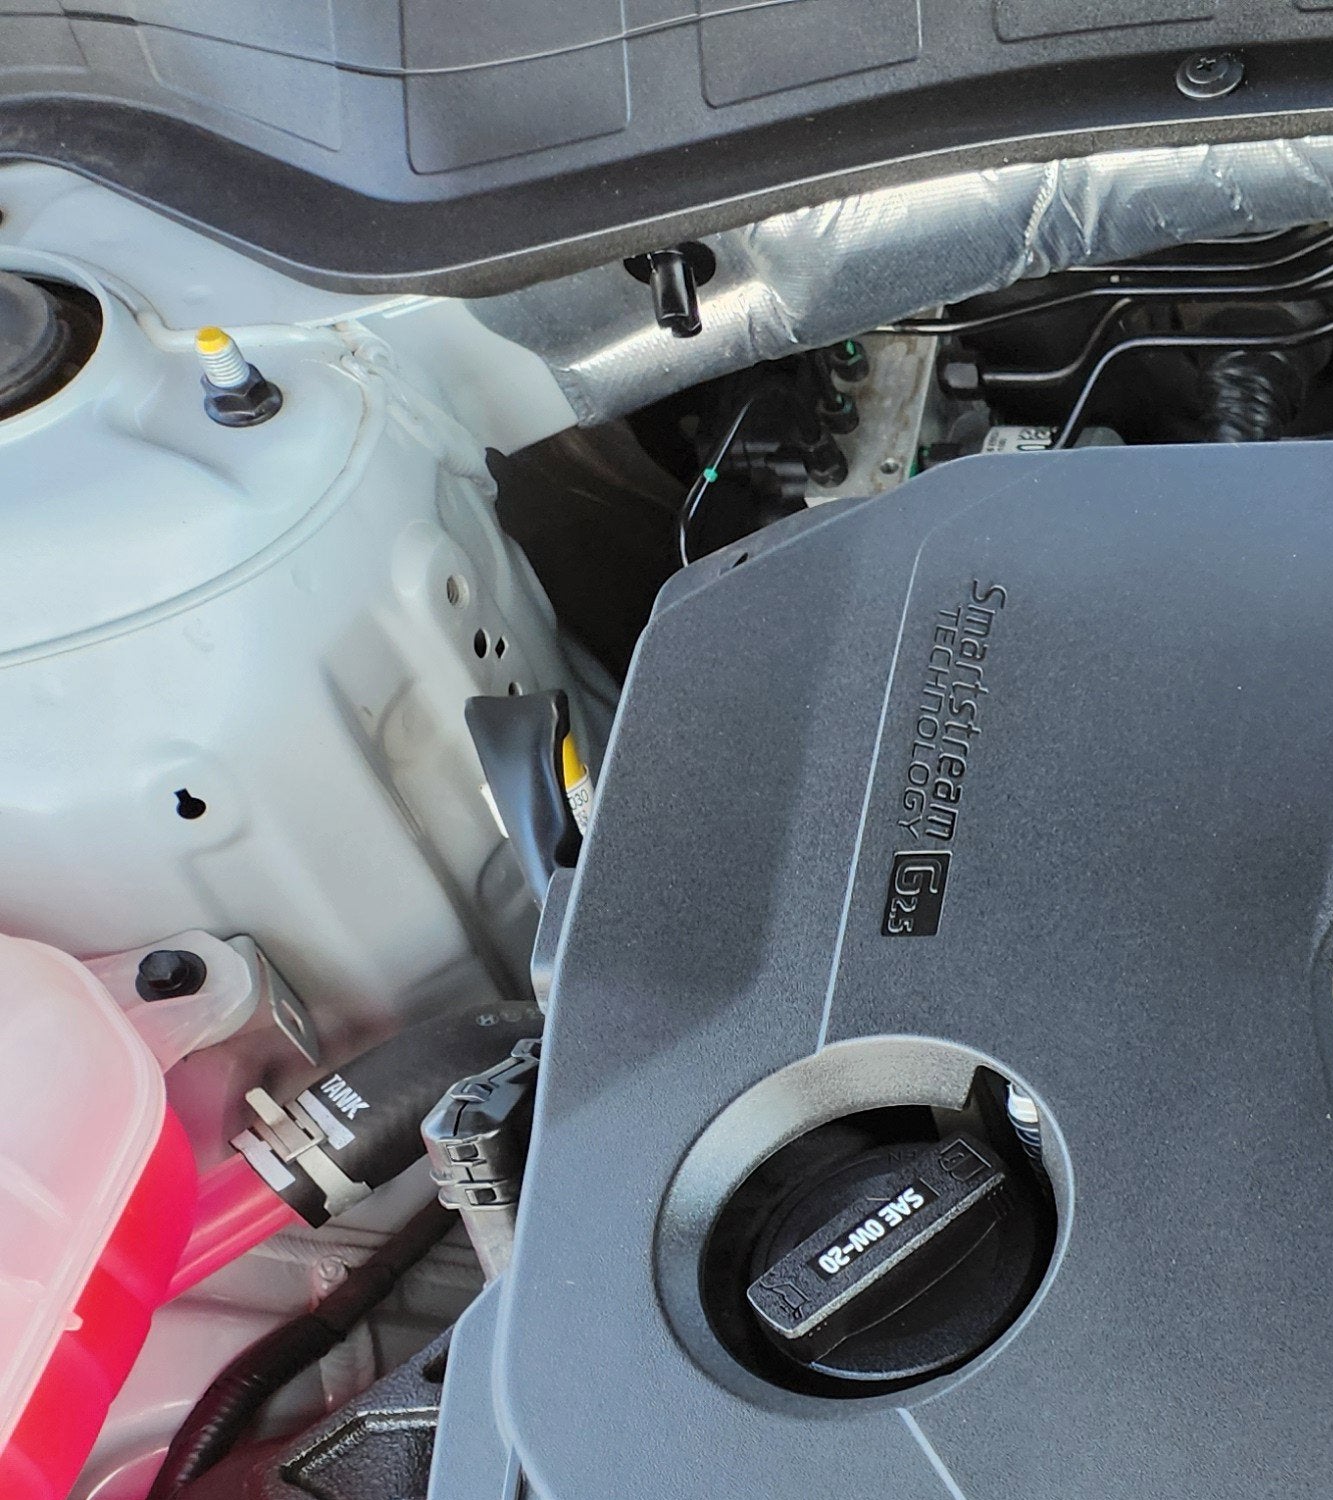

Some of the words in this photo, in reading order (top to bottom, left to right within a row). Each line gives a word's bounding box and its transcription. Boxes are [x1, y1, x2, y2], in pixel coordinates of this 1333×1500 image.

[898, 604, 964, 840] TECHNOLOGY
[925, 577, 1008, 843] Smartstream
[319, 1073, 371, 1121] TANK
[877, 1186, 925, 1228] SAE
[817, 1217, 887, 1275] 0W-20
